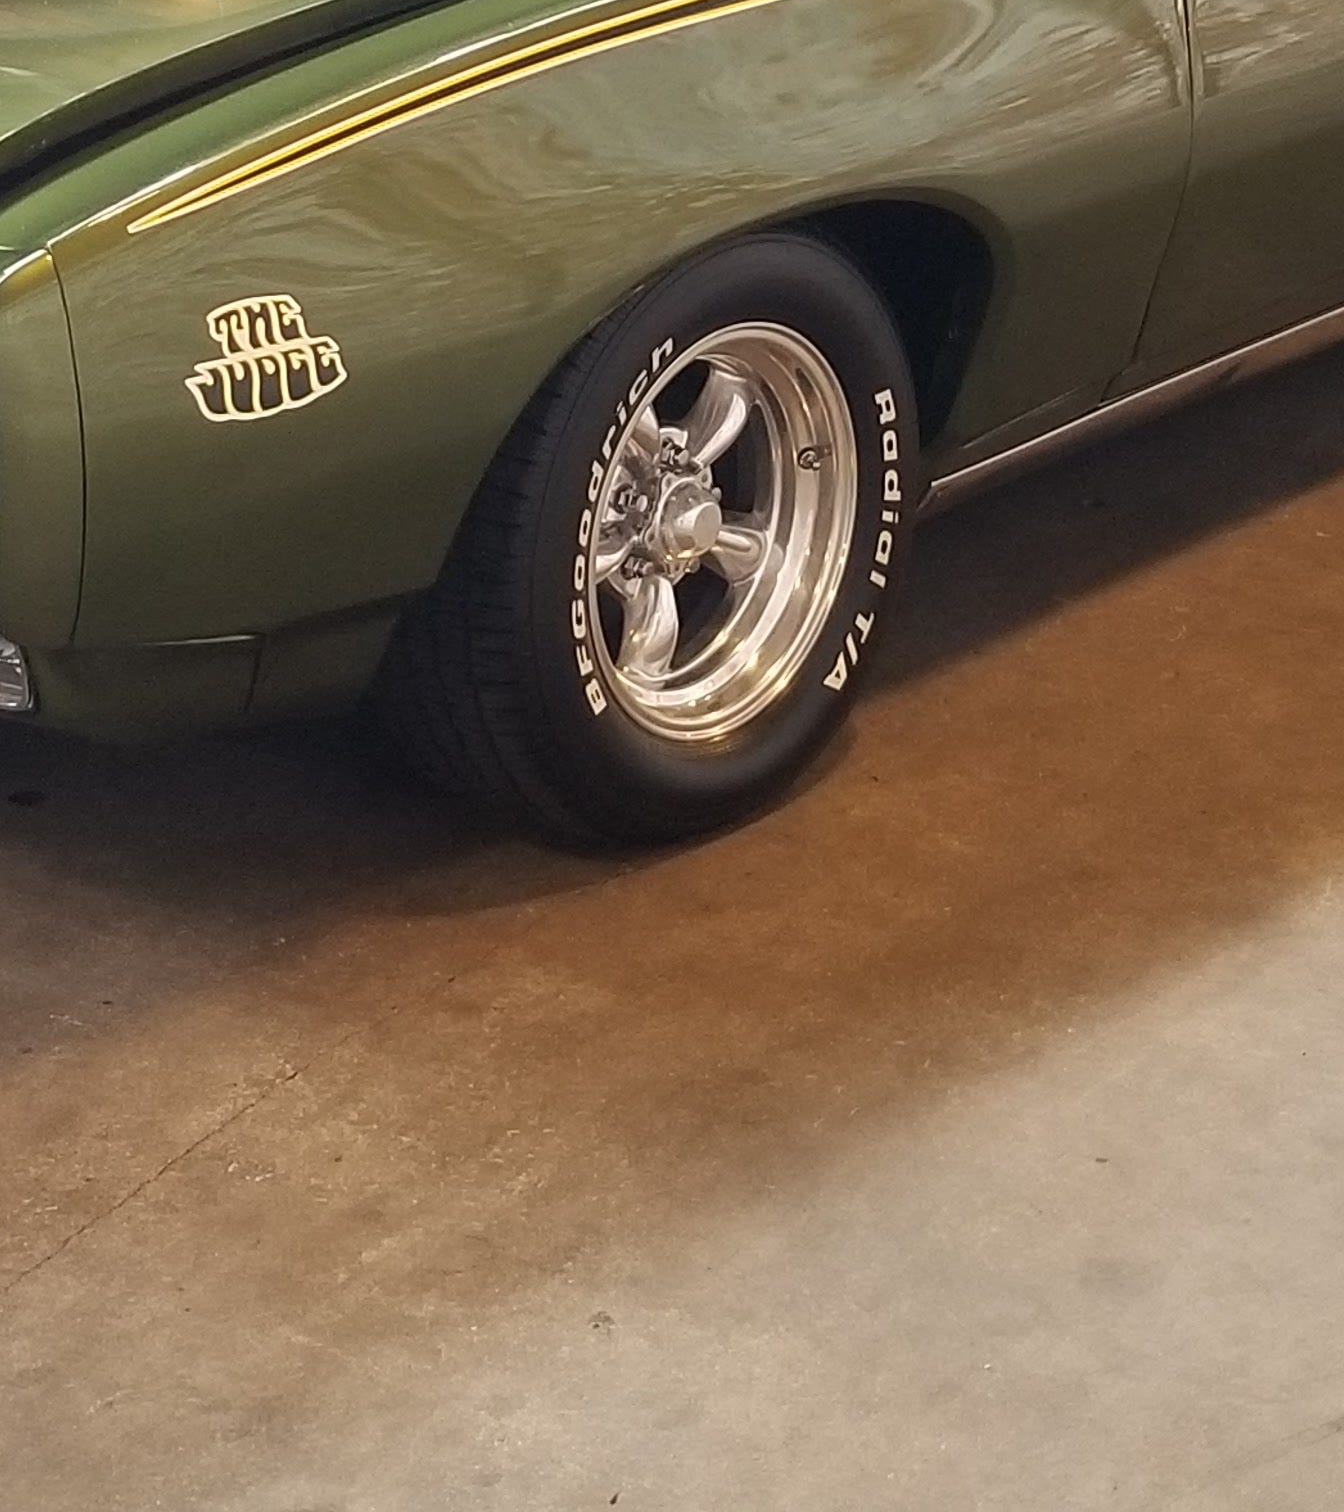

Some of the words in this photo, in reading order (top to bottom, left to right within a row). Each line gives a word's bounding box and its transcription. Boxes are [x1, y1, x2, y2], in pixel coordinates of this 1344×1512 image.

[207, 295, 306, 356] THE
[185, 337, 347, 421] JUDGE
[571, 336, 674, 717] BFGoodrich
[869, 388, 902, 589] Radial
[822, 612, 876, 691] T/A
